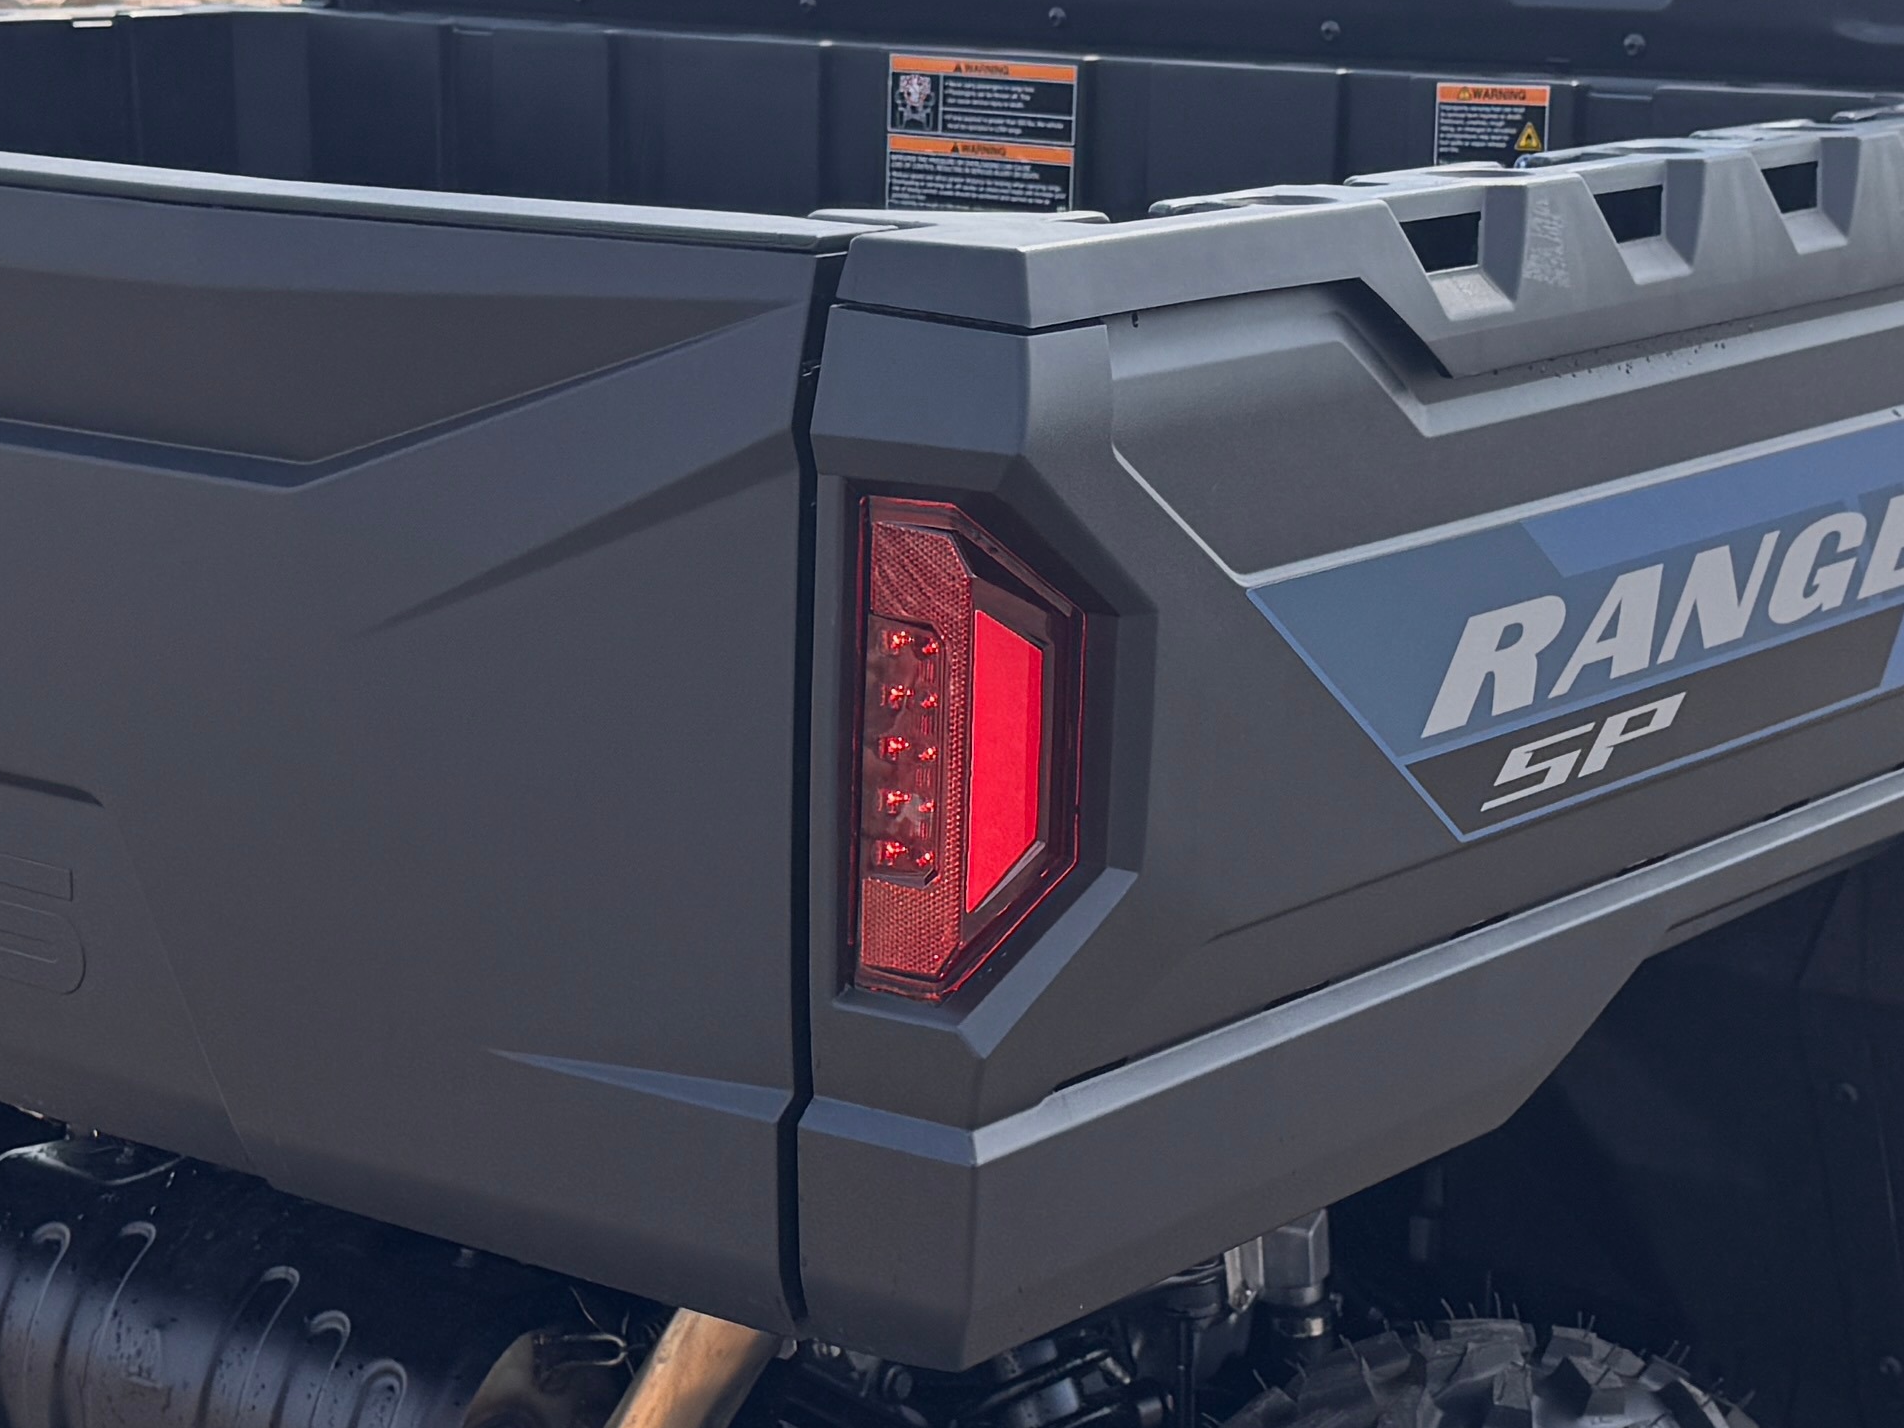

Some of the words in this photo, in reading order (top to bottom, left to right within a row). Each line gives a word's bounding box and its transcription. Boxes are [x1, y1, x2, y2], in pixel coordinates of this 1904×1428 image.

[965, 63, 1009, 76] WARNING
[1472, 87, 1527, 102] WARNING
[961, 143, 1007, 157] WARNING
[1480, 691, 1687, 812] SP
